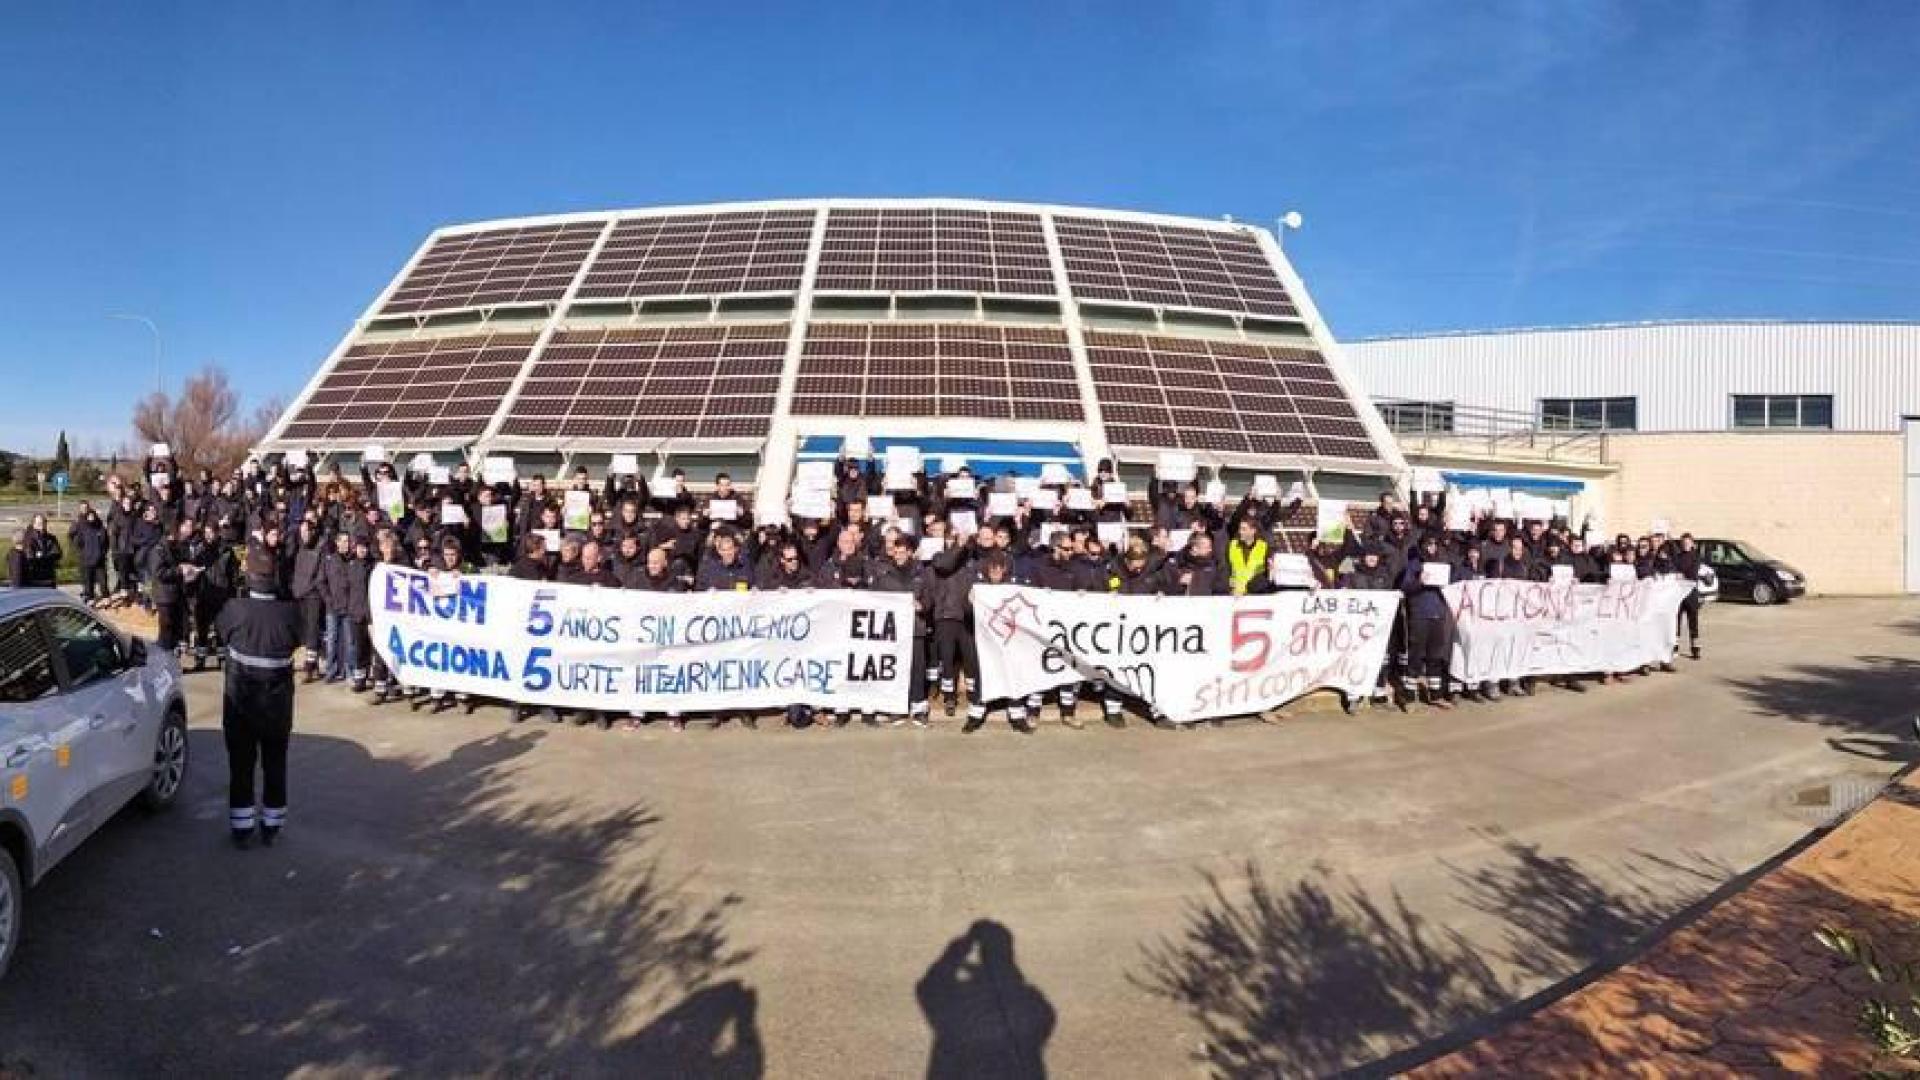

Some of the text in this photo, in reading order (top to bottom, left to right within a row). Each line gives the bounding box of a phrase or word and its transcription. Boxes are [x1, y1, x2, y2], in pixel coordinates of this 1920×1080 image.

[526, 589, 557, 636] 5
[637, 615, 676, 645] SIN
[684, 611, 811, 645] CONVENIO
[851, 610, 897, 641] ELA
[1302, 597, 1379, 615] LAB ELA
[387, 624, 511, 681] ACCIONA
[1048, 613, 1207, 655] acciona
[1231, 608, 1377, 673] 5 años
[523, 646, 553, 690] 5
[557, 661, 623, 694] URTE
[774, 657, 842, 694] GABE
[847, 651, 897, 681] LAB
[1191, 674, 1251, 714] sin
